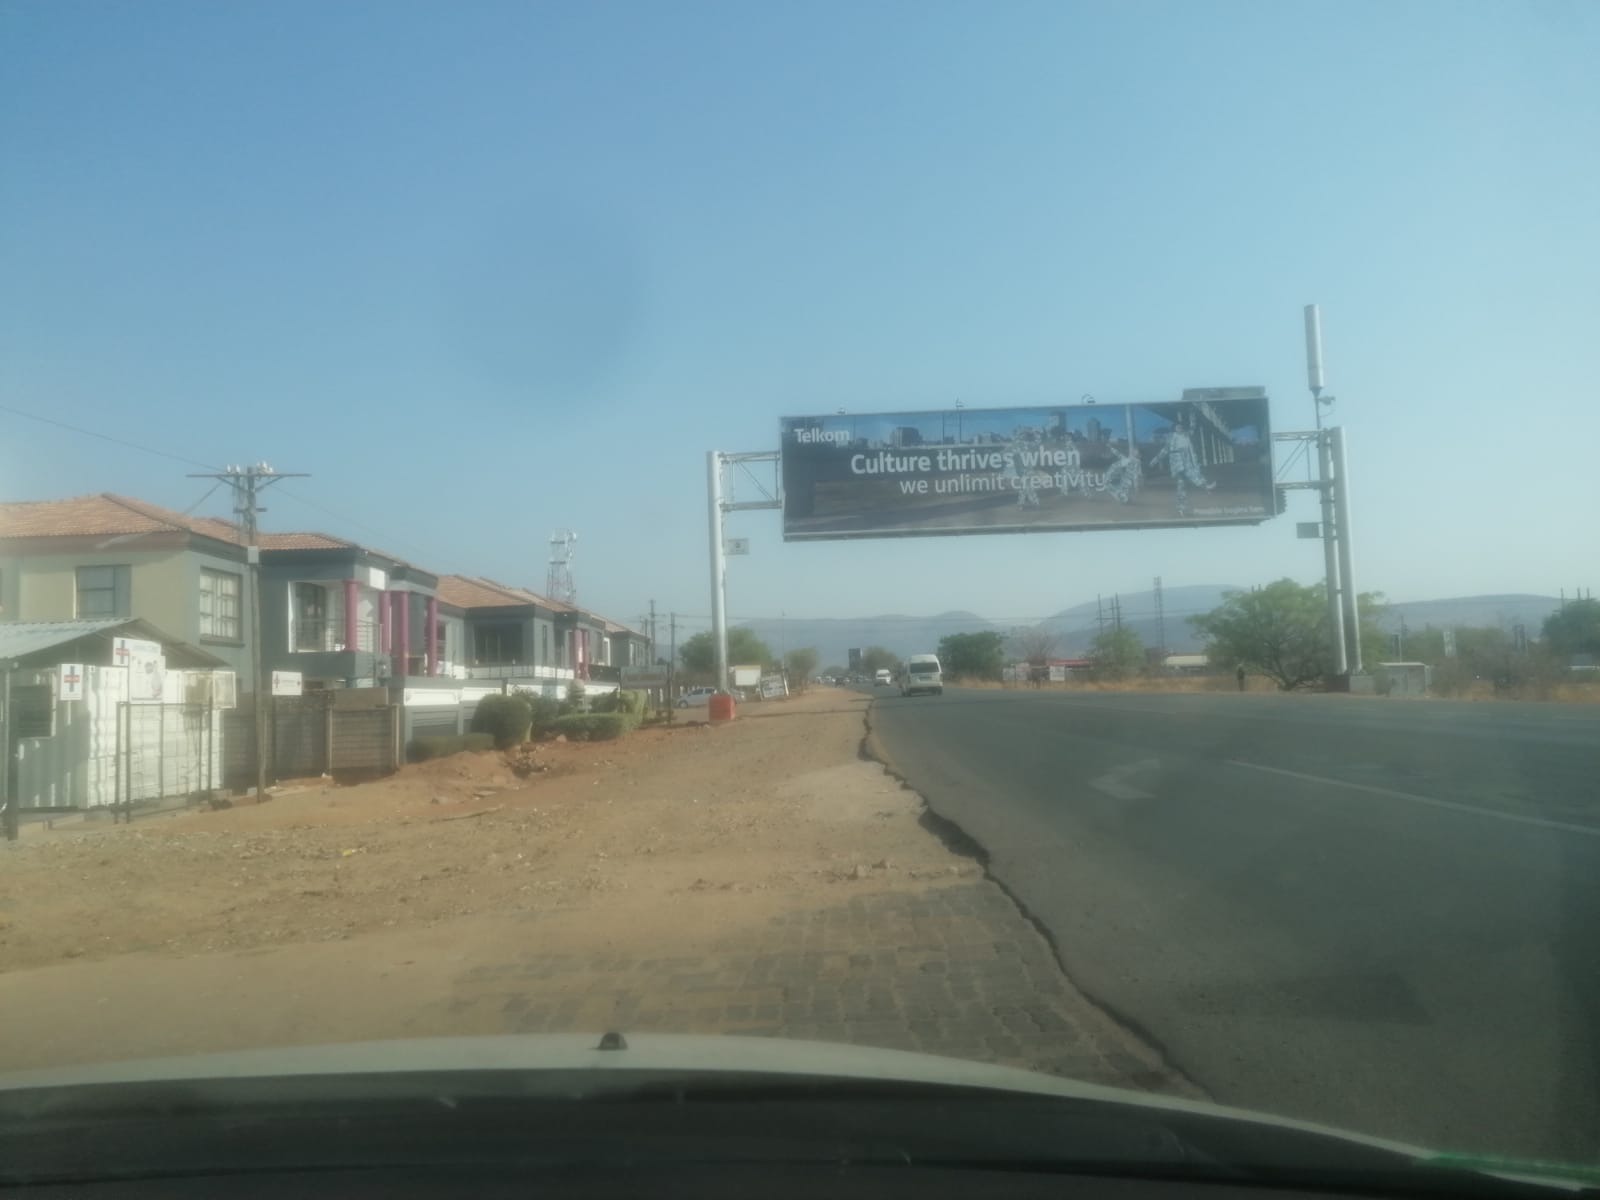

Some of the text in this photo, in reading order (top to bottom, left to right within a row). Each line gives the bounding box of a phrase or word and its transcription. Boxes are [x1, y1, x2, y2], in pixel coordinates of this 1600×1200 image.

[793, 427, 850, 443] Telkom
[851, 445, 1081, 474] Culture thrives when
[899, 470, 1106, 494] we unlimit creativity
